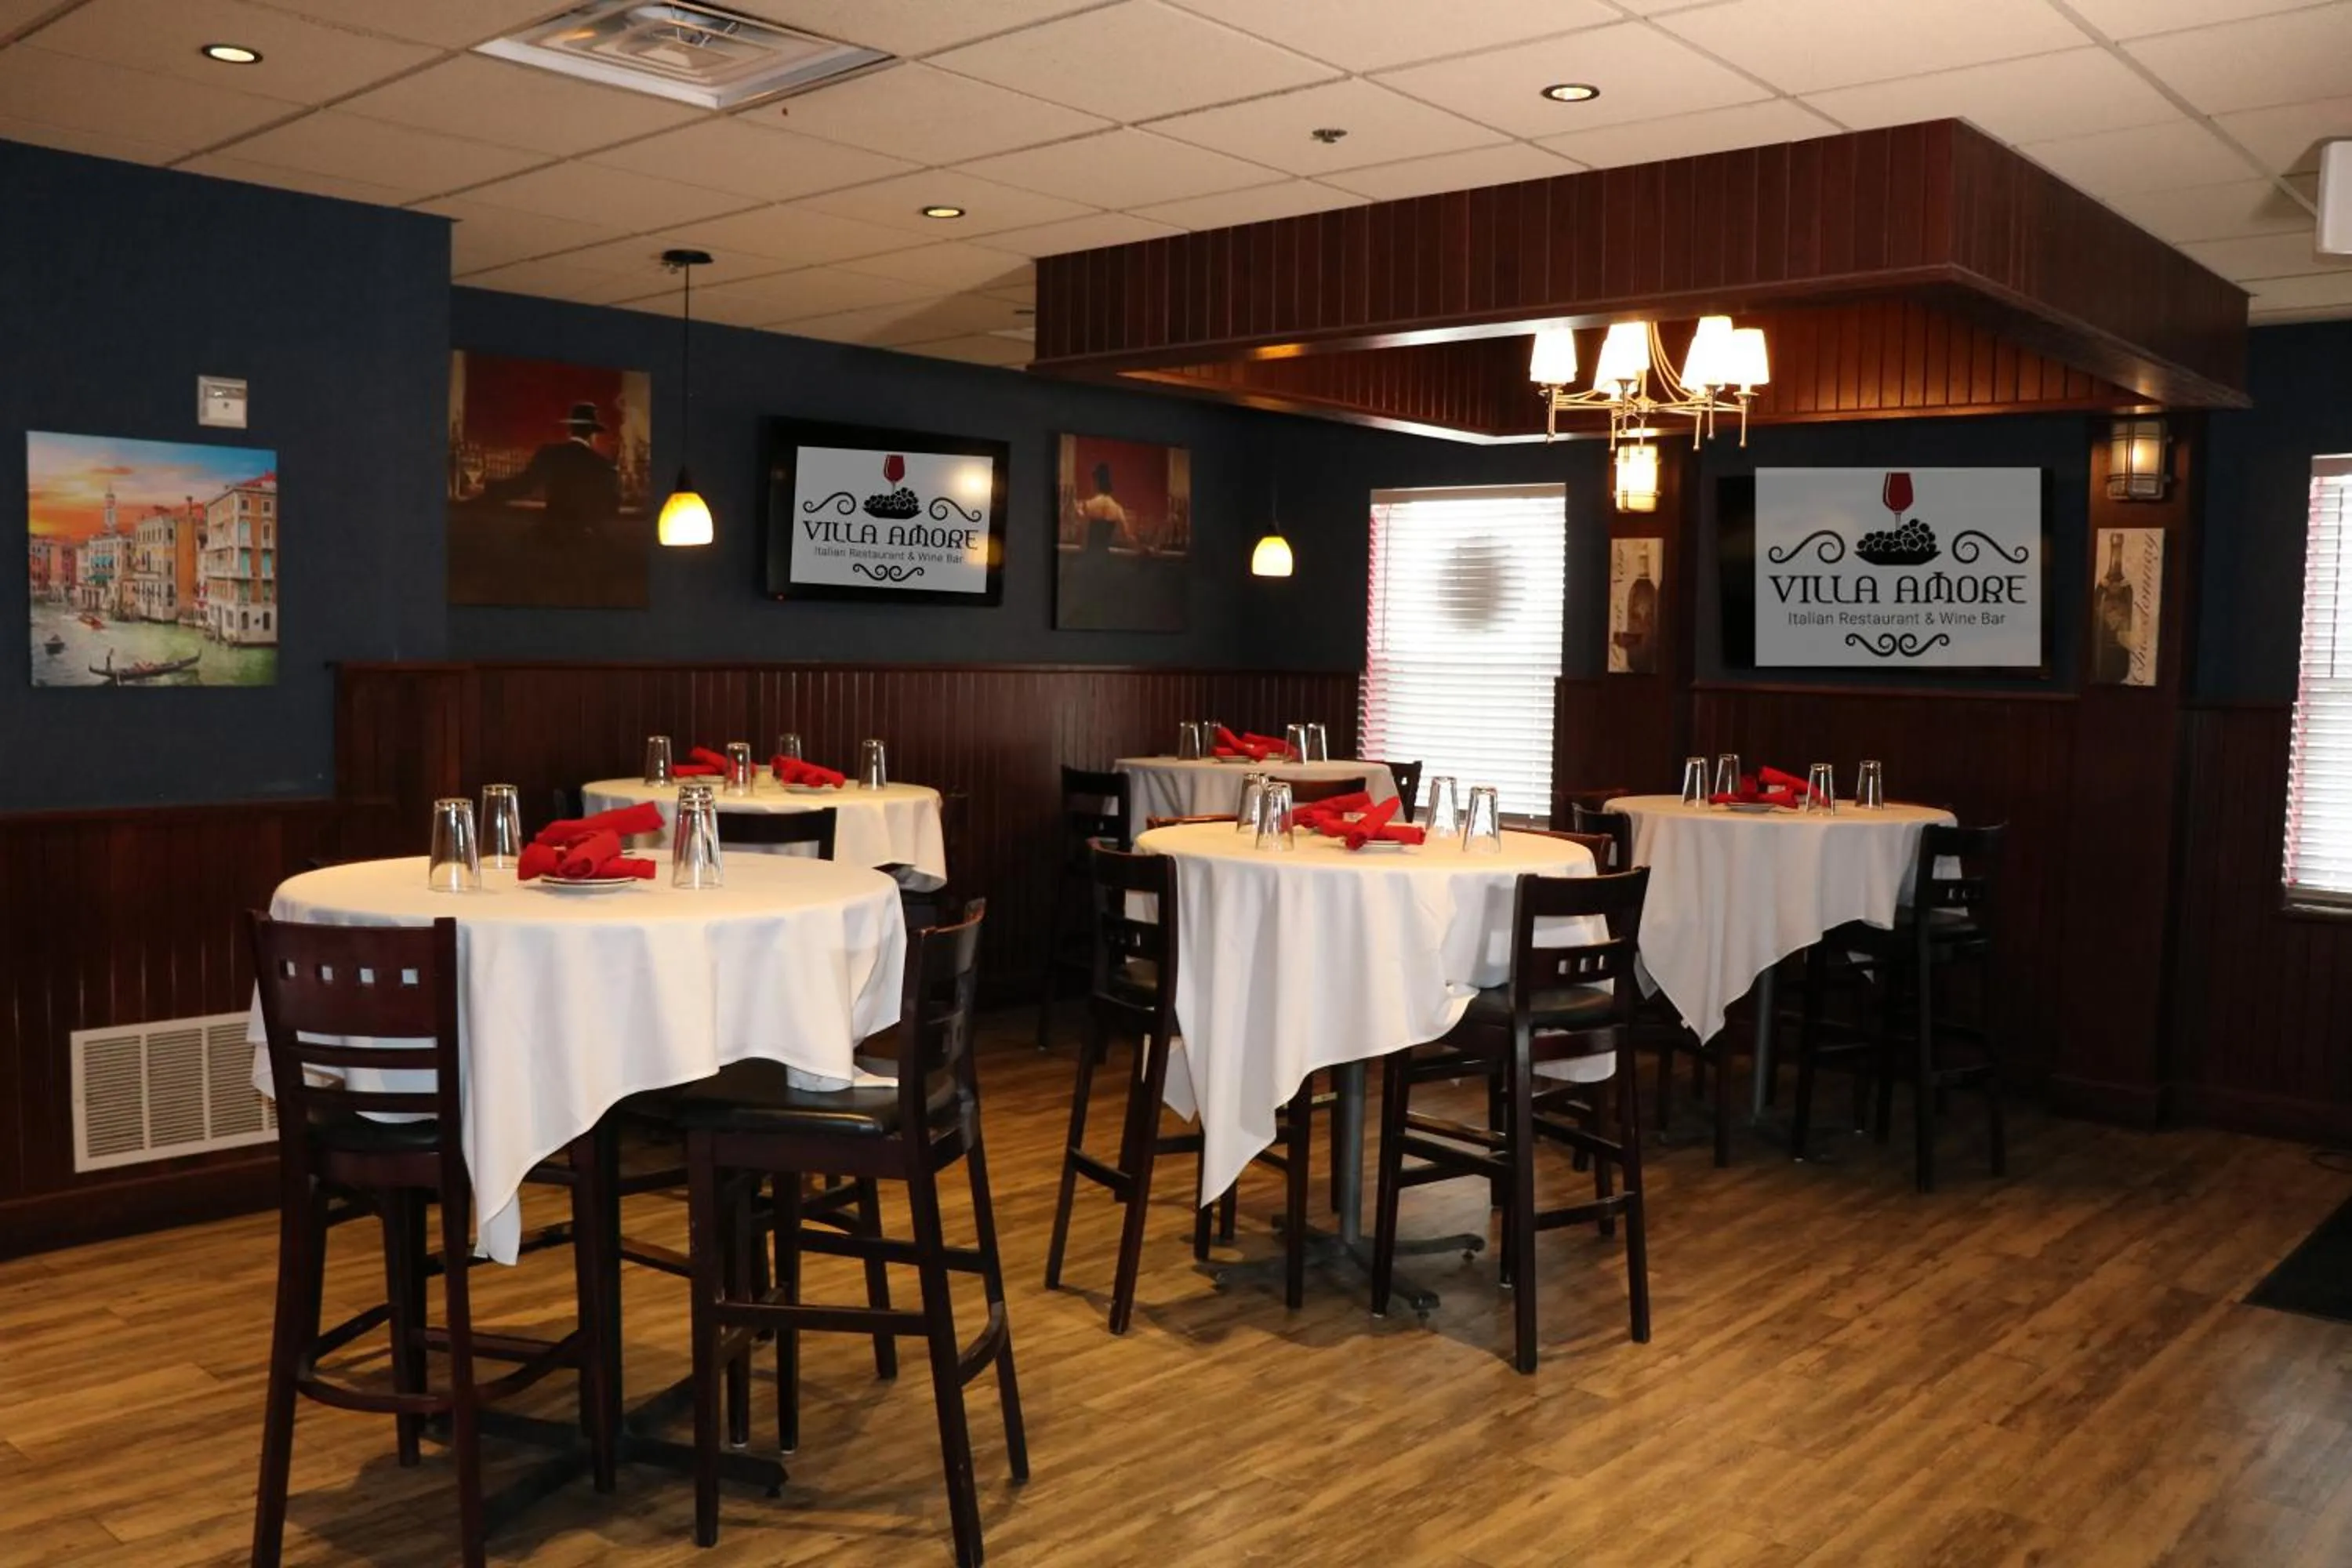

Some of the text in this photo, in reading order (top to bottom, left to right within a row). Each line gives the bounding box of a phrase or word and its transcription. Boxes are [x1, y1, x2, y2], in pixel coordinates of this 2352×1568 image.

[803, 521, 978, 550] VILLA AMORE
[815, 546, 964, 564] Italian Restaurant & Wine Bar
[1768, 572, 2027, 604] VILLA AMORE
[1788, 612, 2006, 626] Italian Restaurant & Wine Bar
